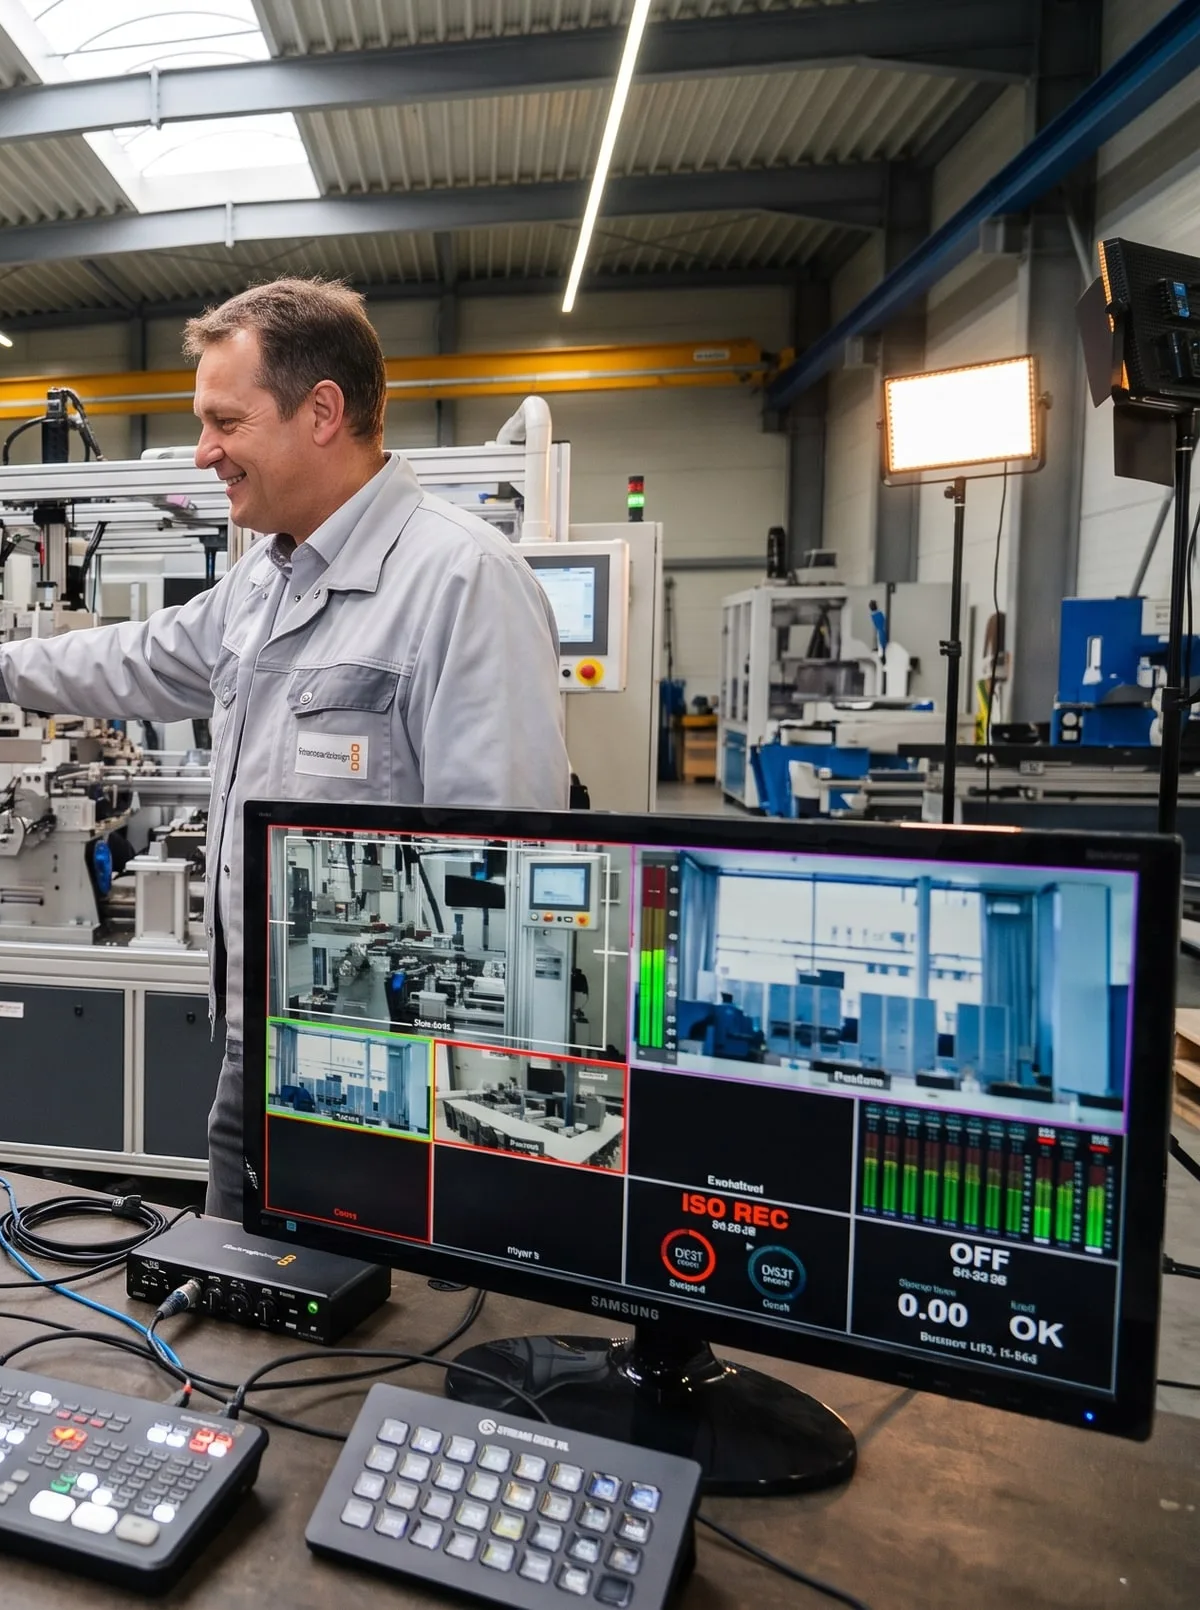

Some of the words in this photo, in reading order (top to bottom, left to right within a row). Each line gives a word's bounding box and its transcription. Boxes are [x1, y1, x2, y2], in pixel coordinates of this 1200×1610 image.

[681, 1193, 726, 1218] ISO
[734, 1201, 790, 1230] REC
[949, 1242, 1010, 1271] OFF
[591, 1295, 659, 1320] SAMSUNG
[897, 1293, 968, 1327] 0.00
[1009, 1315, 1064, 1348] OK
